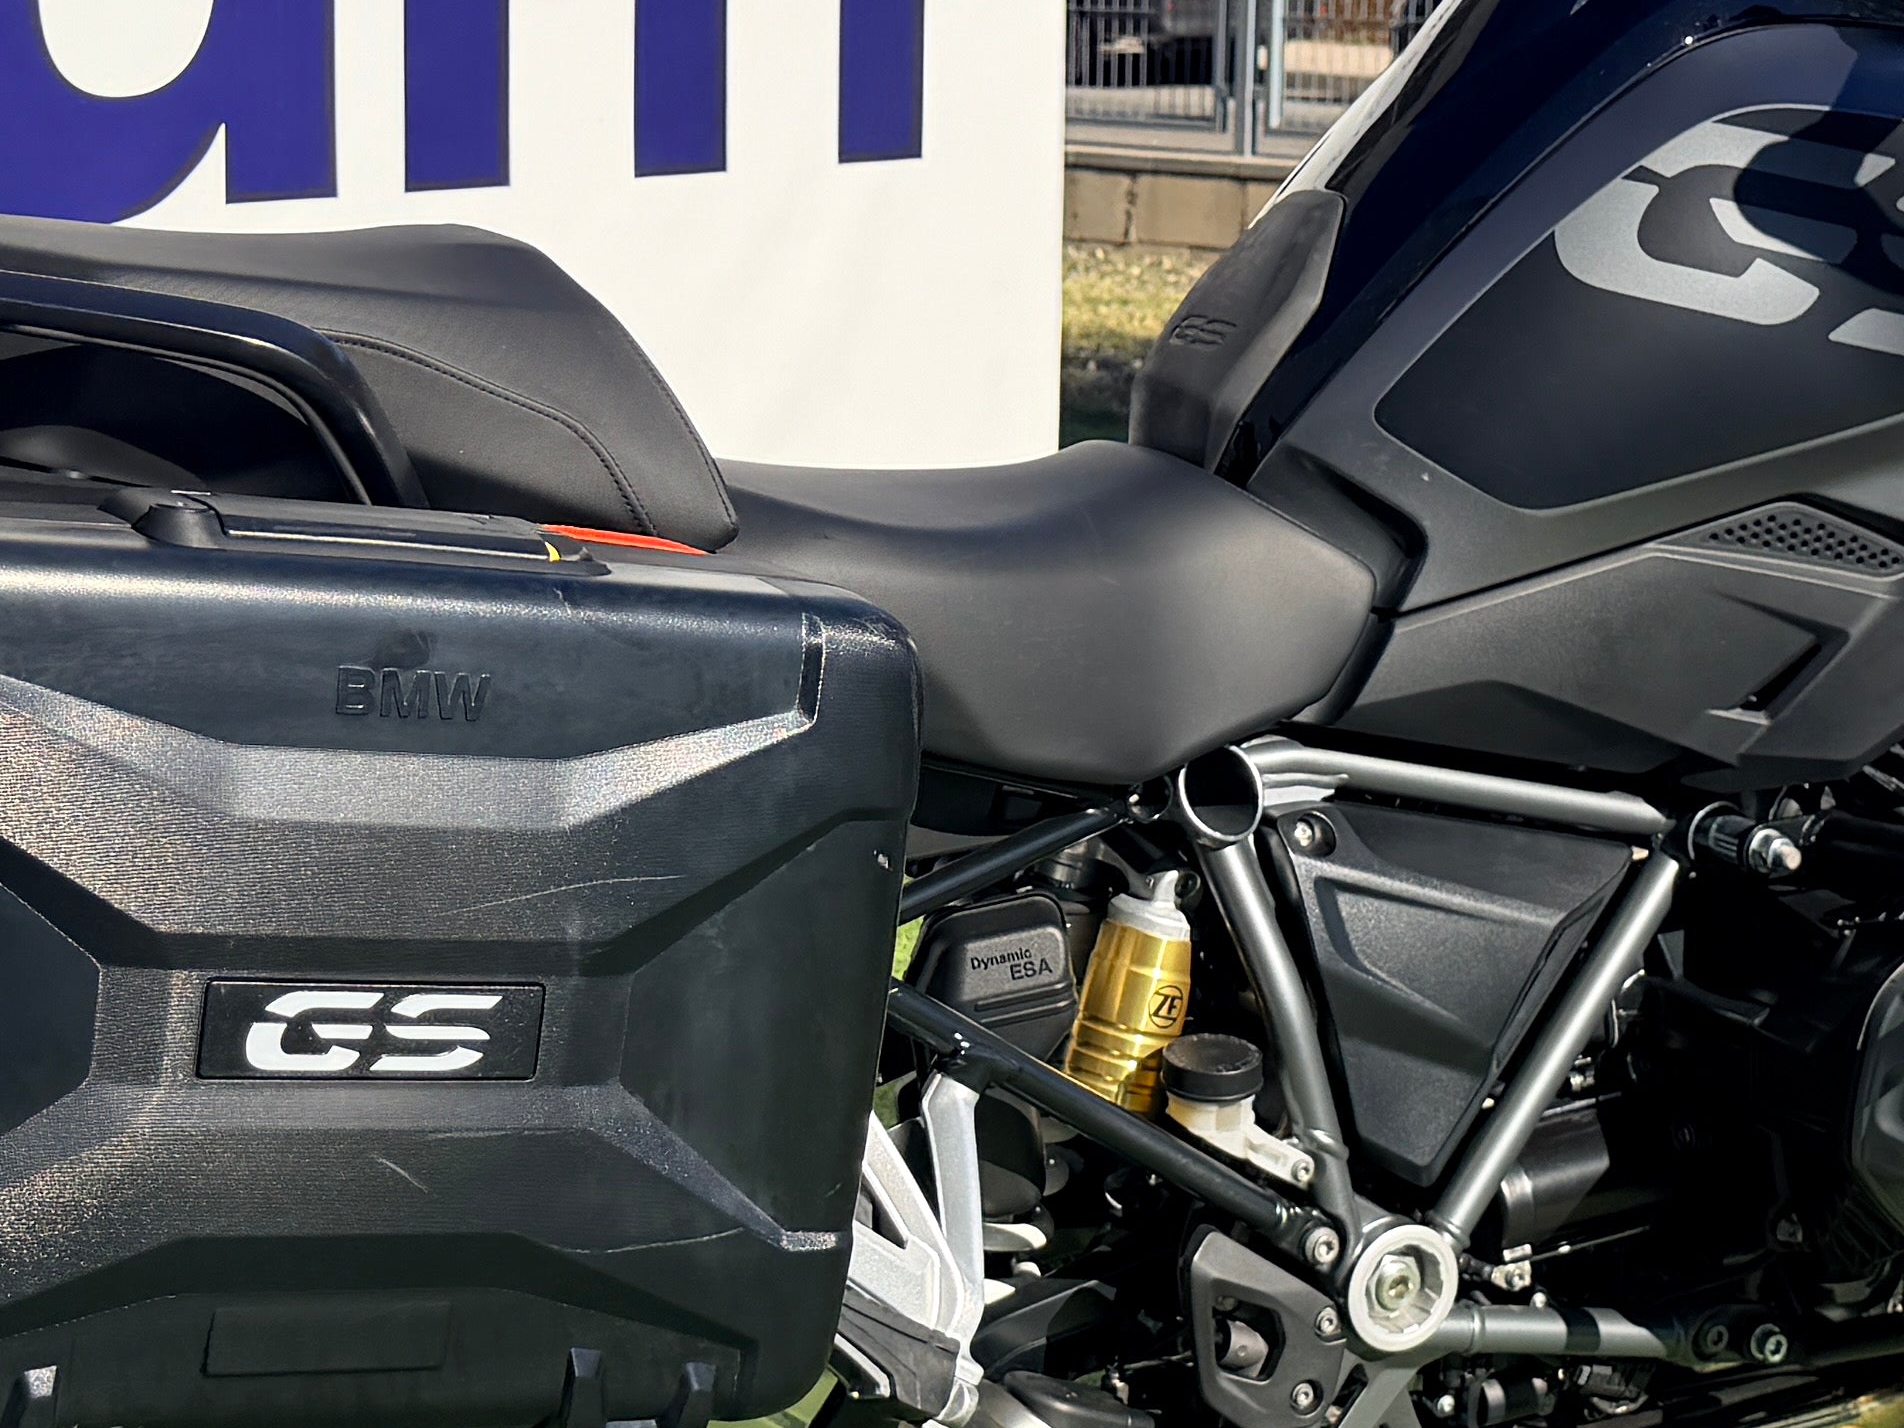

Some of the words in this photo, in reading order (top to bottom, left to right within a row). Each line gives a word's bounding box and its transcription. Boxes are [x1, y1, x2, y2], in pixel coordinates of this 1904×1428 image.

[336, 664, 492, 722] BMW
[971, 947, 1032, 971] Dynamic
[1009, 958, 1054, 981] ESA
[1151, 992, 1184, 1022] ZF
[246, 990, 503, 1072] GS
